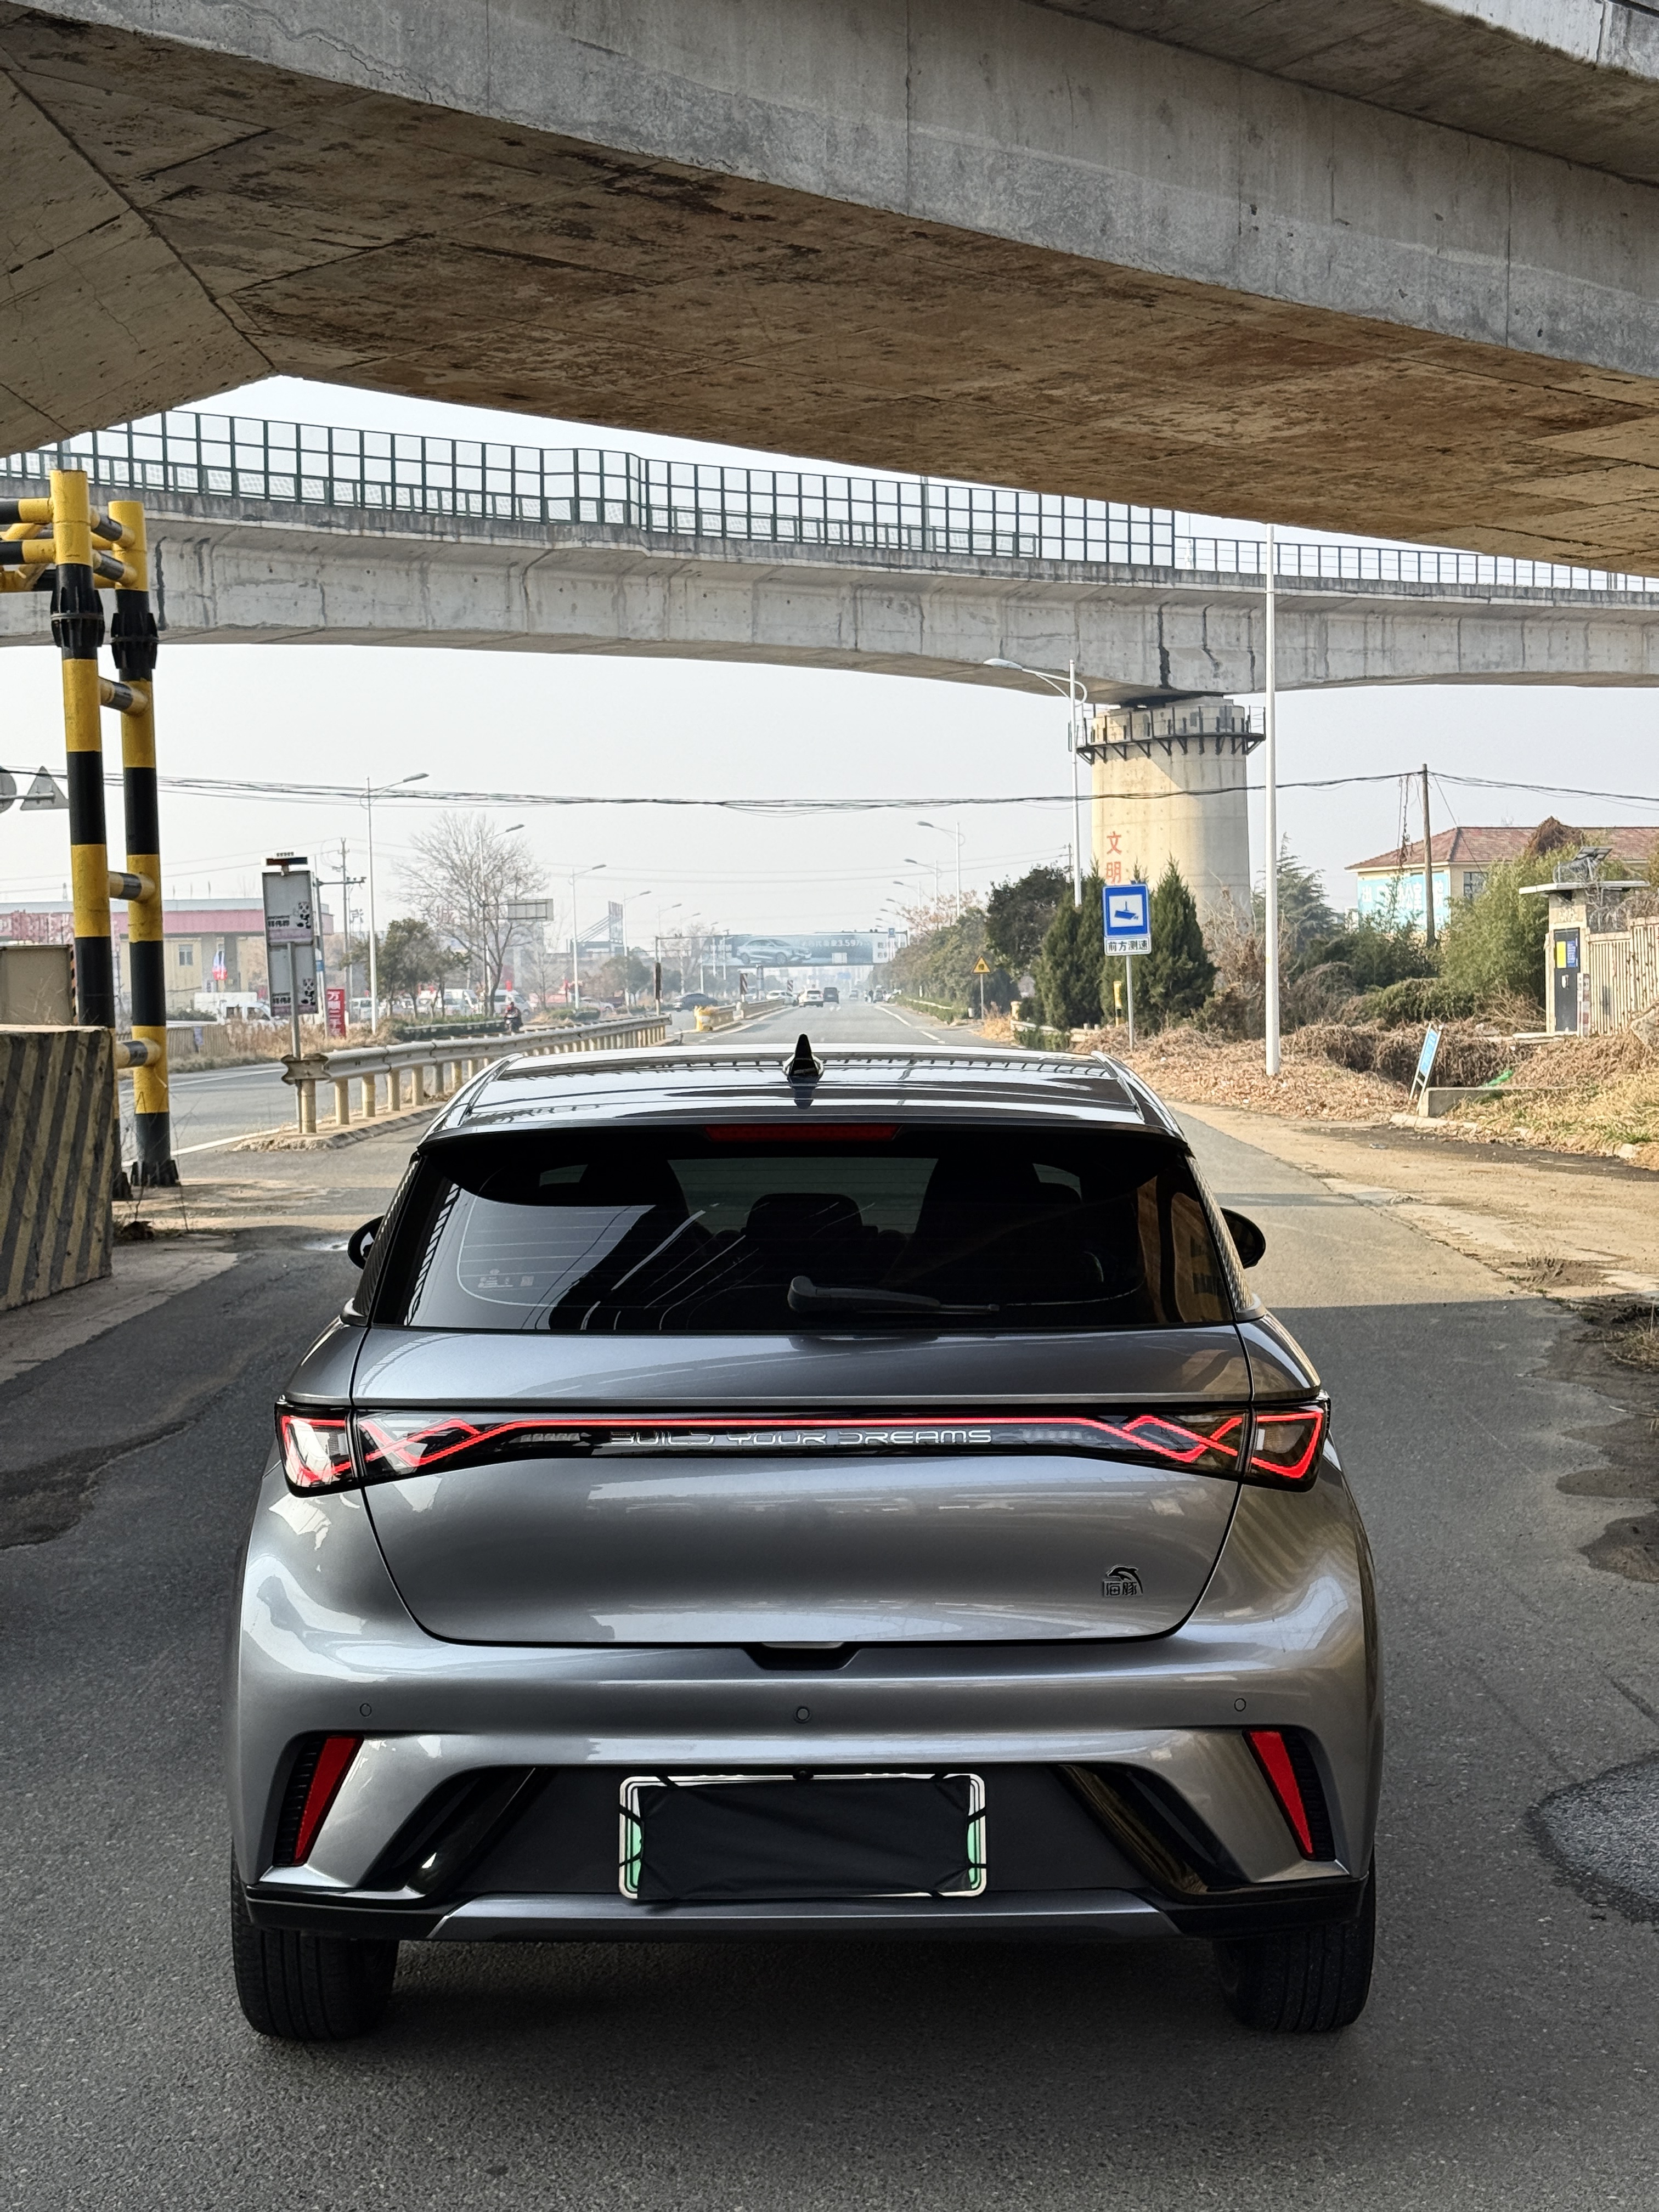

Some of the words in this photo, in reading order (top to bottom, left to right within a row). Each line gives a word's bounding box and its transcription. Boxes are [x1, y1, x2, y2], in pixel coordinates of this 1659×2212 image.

[1105, 831, 1122, 884] 文明
[1108, 940, 1148, 951] 前方测速
[611, 1431, 714, 1445] BUILD
[727, 1431, 826, 1445] YOUR
[839, 1429, 992, 1444] DREAMS
[1105, 1582, 1137, 1596] 海豚
